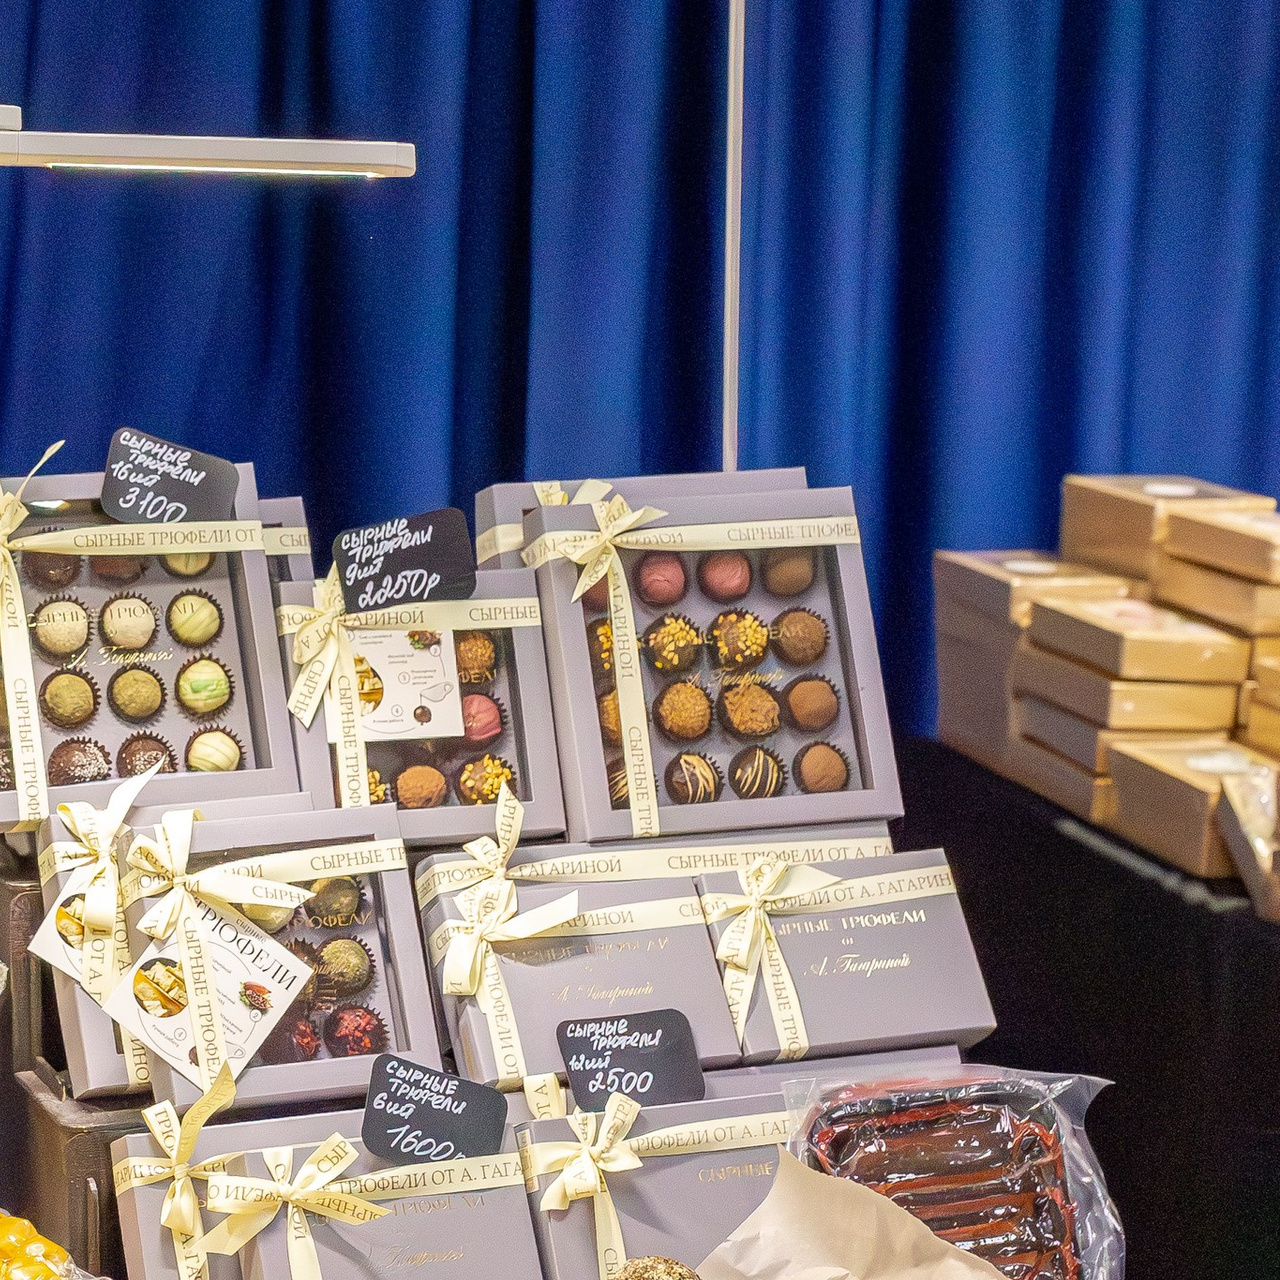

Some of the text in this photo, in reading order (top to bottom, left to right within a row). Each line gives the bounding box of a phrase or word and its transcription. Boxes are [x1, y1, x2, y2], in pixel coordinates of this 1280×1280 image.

[73, 528, 256, 548] СЫРНЫЕ ТРЮФЕЛИ ОТ
[469, 605, 538, 622] СЫРНЫЕ
[310, 848, 384, 870] СЫРНЫЕ
[668, 852, 738, 870] СЫРНЫЕ
[828, 846, 851, 862] ОТ
[834, 887, 855, 903] ОТ
[182, 916, 210, 997] СЫРНЫЕ
[588, 1068, 654, 1093] 2500
[714, 1126, 736, 1142] ОТ
[432, 1169, 455, 1184] ОТ
